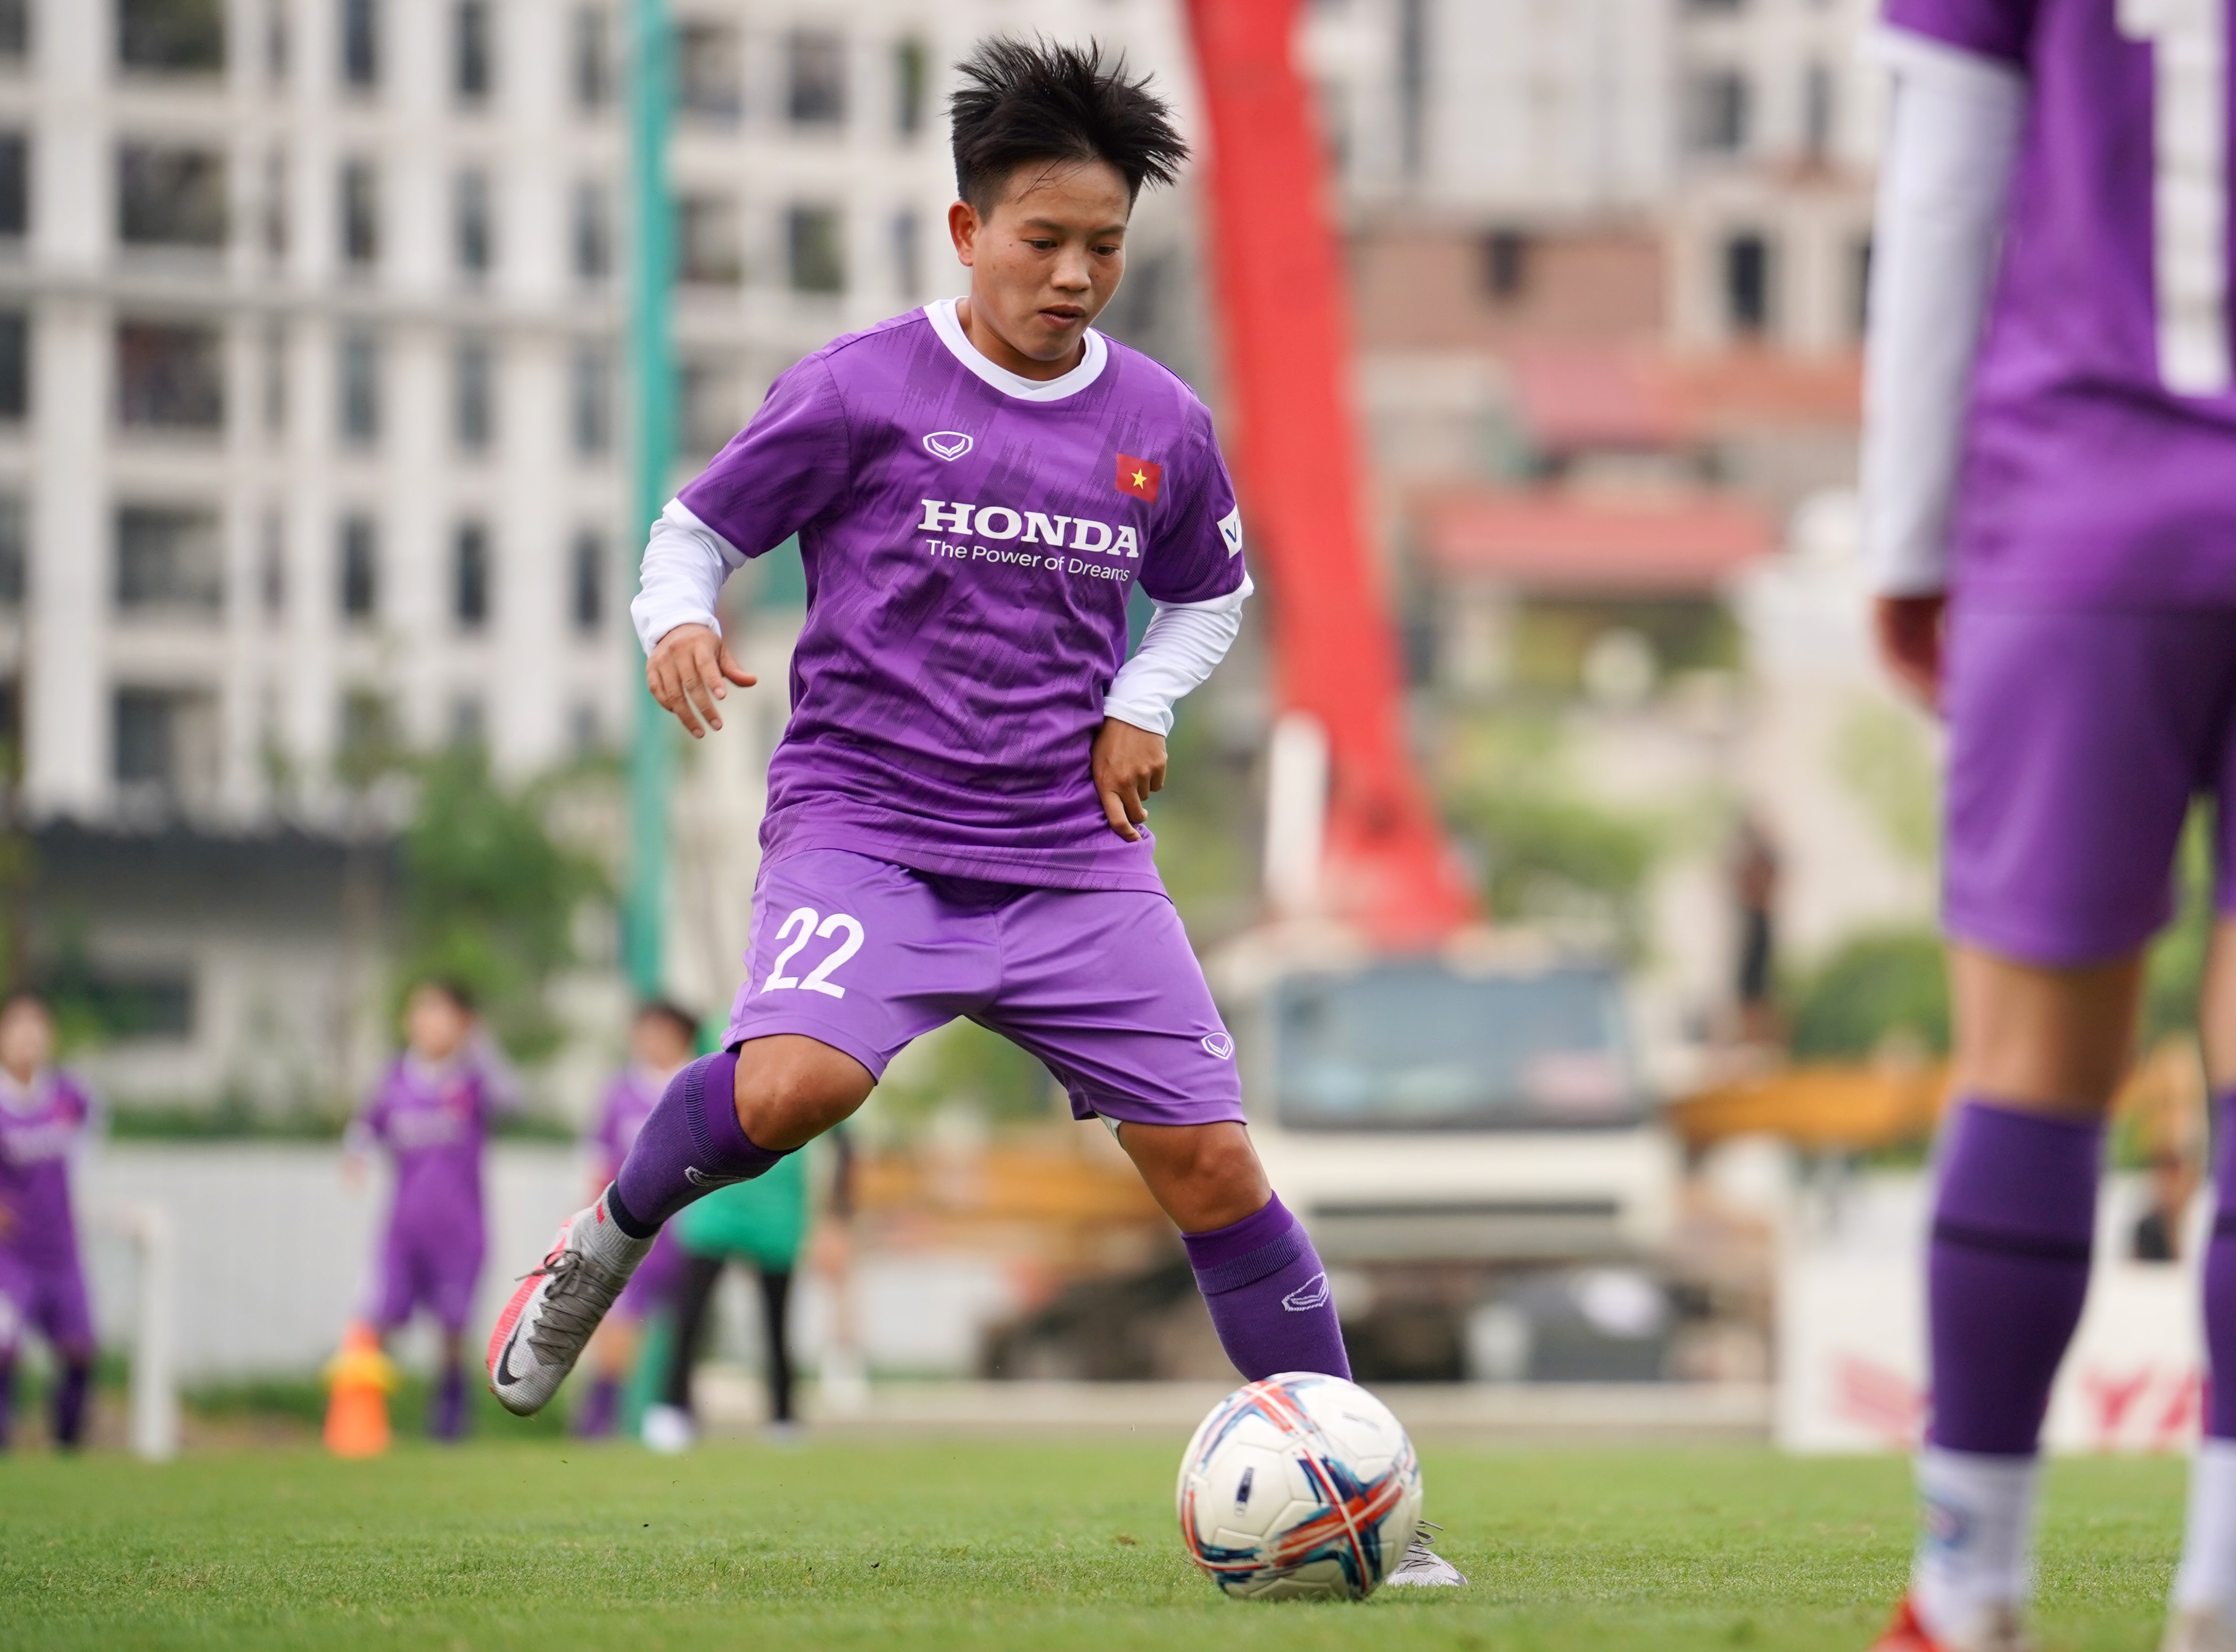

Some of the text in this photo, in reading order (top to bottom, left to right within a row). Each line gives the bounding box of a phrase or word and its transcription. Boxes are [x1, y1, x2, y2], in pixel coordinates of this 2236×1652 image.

[918, 499, 1139, 558] HONDA
[926, 539, 1130, 582] The Power of Dreams
[760, 907, 865, 999] 22
